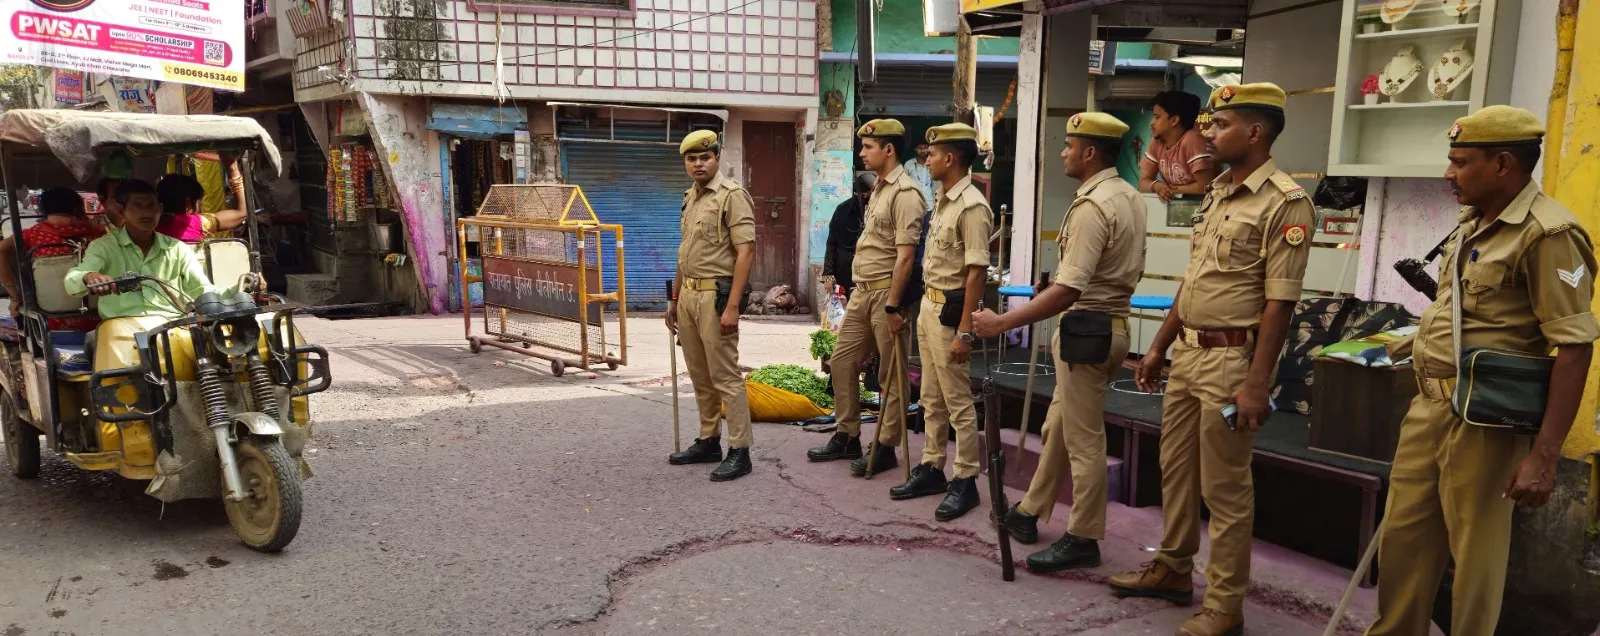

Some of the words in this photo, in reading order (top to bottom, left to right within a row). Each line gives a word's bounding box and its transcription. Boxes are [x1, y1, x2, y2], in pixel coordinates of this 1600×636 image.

[128, 4, 143, 12] JEE
[148, 6, 168, 16] NEET
[174, 10, 222, 25] Foundation
[19, 15, 101, 40] PWSAT
[126, 32, 144, 41] 90%
[144, 34, 193, 48] SCHOLARSHIP
[173, 68, 238, 83] 08069453340
[514, 268, 532, 300] पुलिस
[536, 270, 564, 301] पीलीभीत
